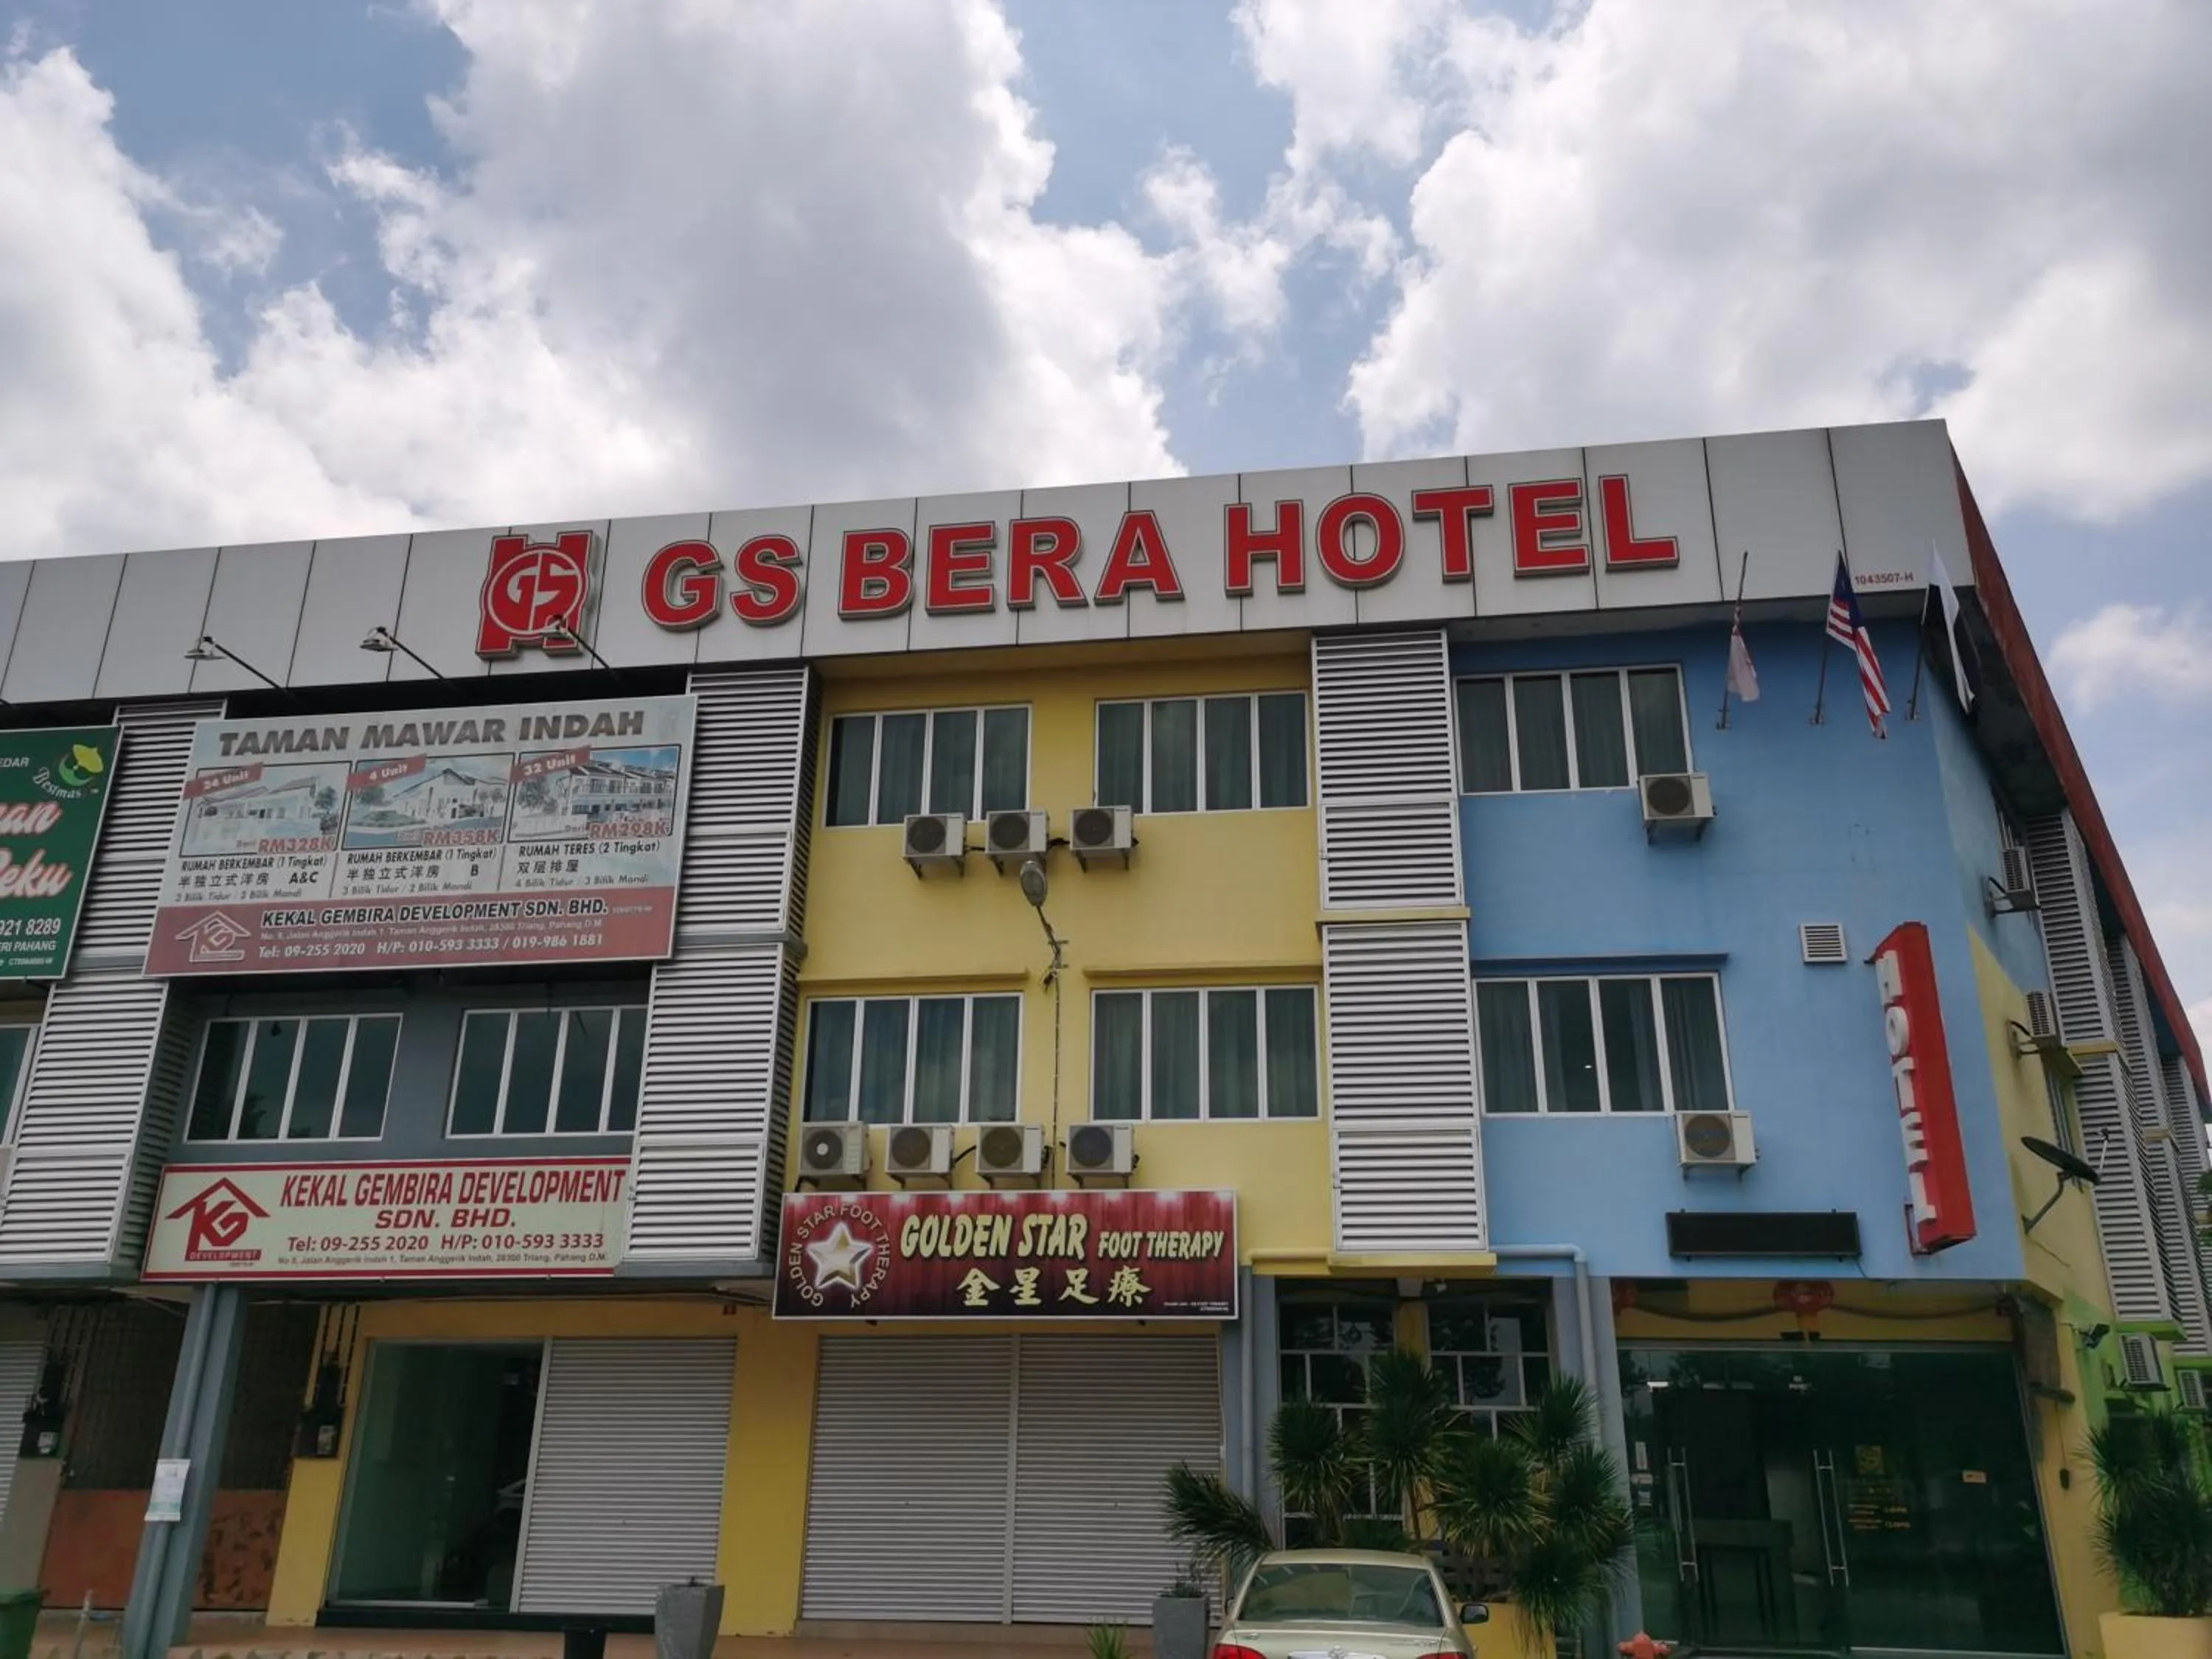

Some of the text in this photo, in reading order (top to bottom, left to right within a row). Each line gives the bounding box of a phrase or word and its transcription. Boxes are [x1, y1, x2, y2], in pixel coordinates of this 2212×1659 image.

[641, 474, 1680, 632] GS BERA HOTEL
[1854, 571, 1914, 586] 1043507-H
[219, 711, 645, 757] TAMAN MAWAR INDAH
[369, 763, 408, 781] 4 Unit
[521, 754, 577, 776] 32 Unit
[223, 771, 249, 784] Unit
[589, 821, 667, 838] RM298K
[258, 836, 333, 853] RM328K
[518, 840, 661, 857] RUMAH TERES (2 Tingkat)
[181, 860, 215, 872] RUMAH
[218, 858, 274, 870] BERKEMBAR
[288, 855, 327, 869] Tingkat)
[347, 852, 382, 864] RUMAH
[386, 849, 442, 862] BERKEMBAR
[456, 846, 497, 862] Tingkat)
[289, 871, 319, 884] A&C
[470, 864, 479, 877] B
[262, 911, 316, 926] KEKAL
[321, 907, 394, 924] GEMBIRA
[400, 902, 520, 921] DEVELOPMENT
[525, 900, 563, 916] SDN.
[569, 898, 608, 914] BHD.
[25, 917, 61, 936] 8289
[13, 940, 56, 952] PAHANG
[259, 945, 279, 958] Tel:
[284, 945, 330, 957] 09-255
[333, 942, 365, 956] 2020
[377, 942, 404, 954] H/P:
[408, 939, 463, 953] 010-593
[466, 937, 500, 951] 3333
[512, 935, 567, 948] 019-986
[572, 933, 603, 946] 1881
[1875, 950, 1937, 1224] HOTEL
[280, 1169, 626, 1207] KEKAL GEMBIRA DEVELOPMENT
[375, 1208, 515, 1229] SDN. BHD.
[288, 1233, 604, 1252] Tel: 09-255 2020 H/P: 010-593 3333
[899, 1213, 1225, 1261] GOLDEN STAR FOOT THERAPY
[788, 1203, 890, 1309] GOLDEN STAR FOOT THERAPY
[955, 1265, 1152, 1307] 金星足療
